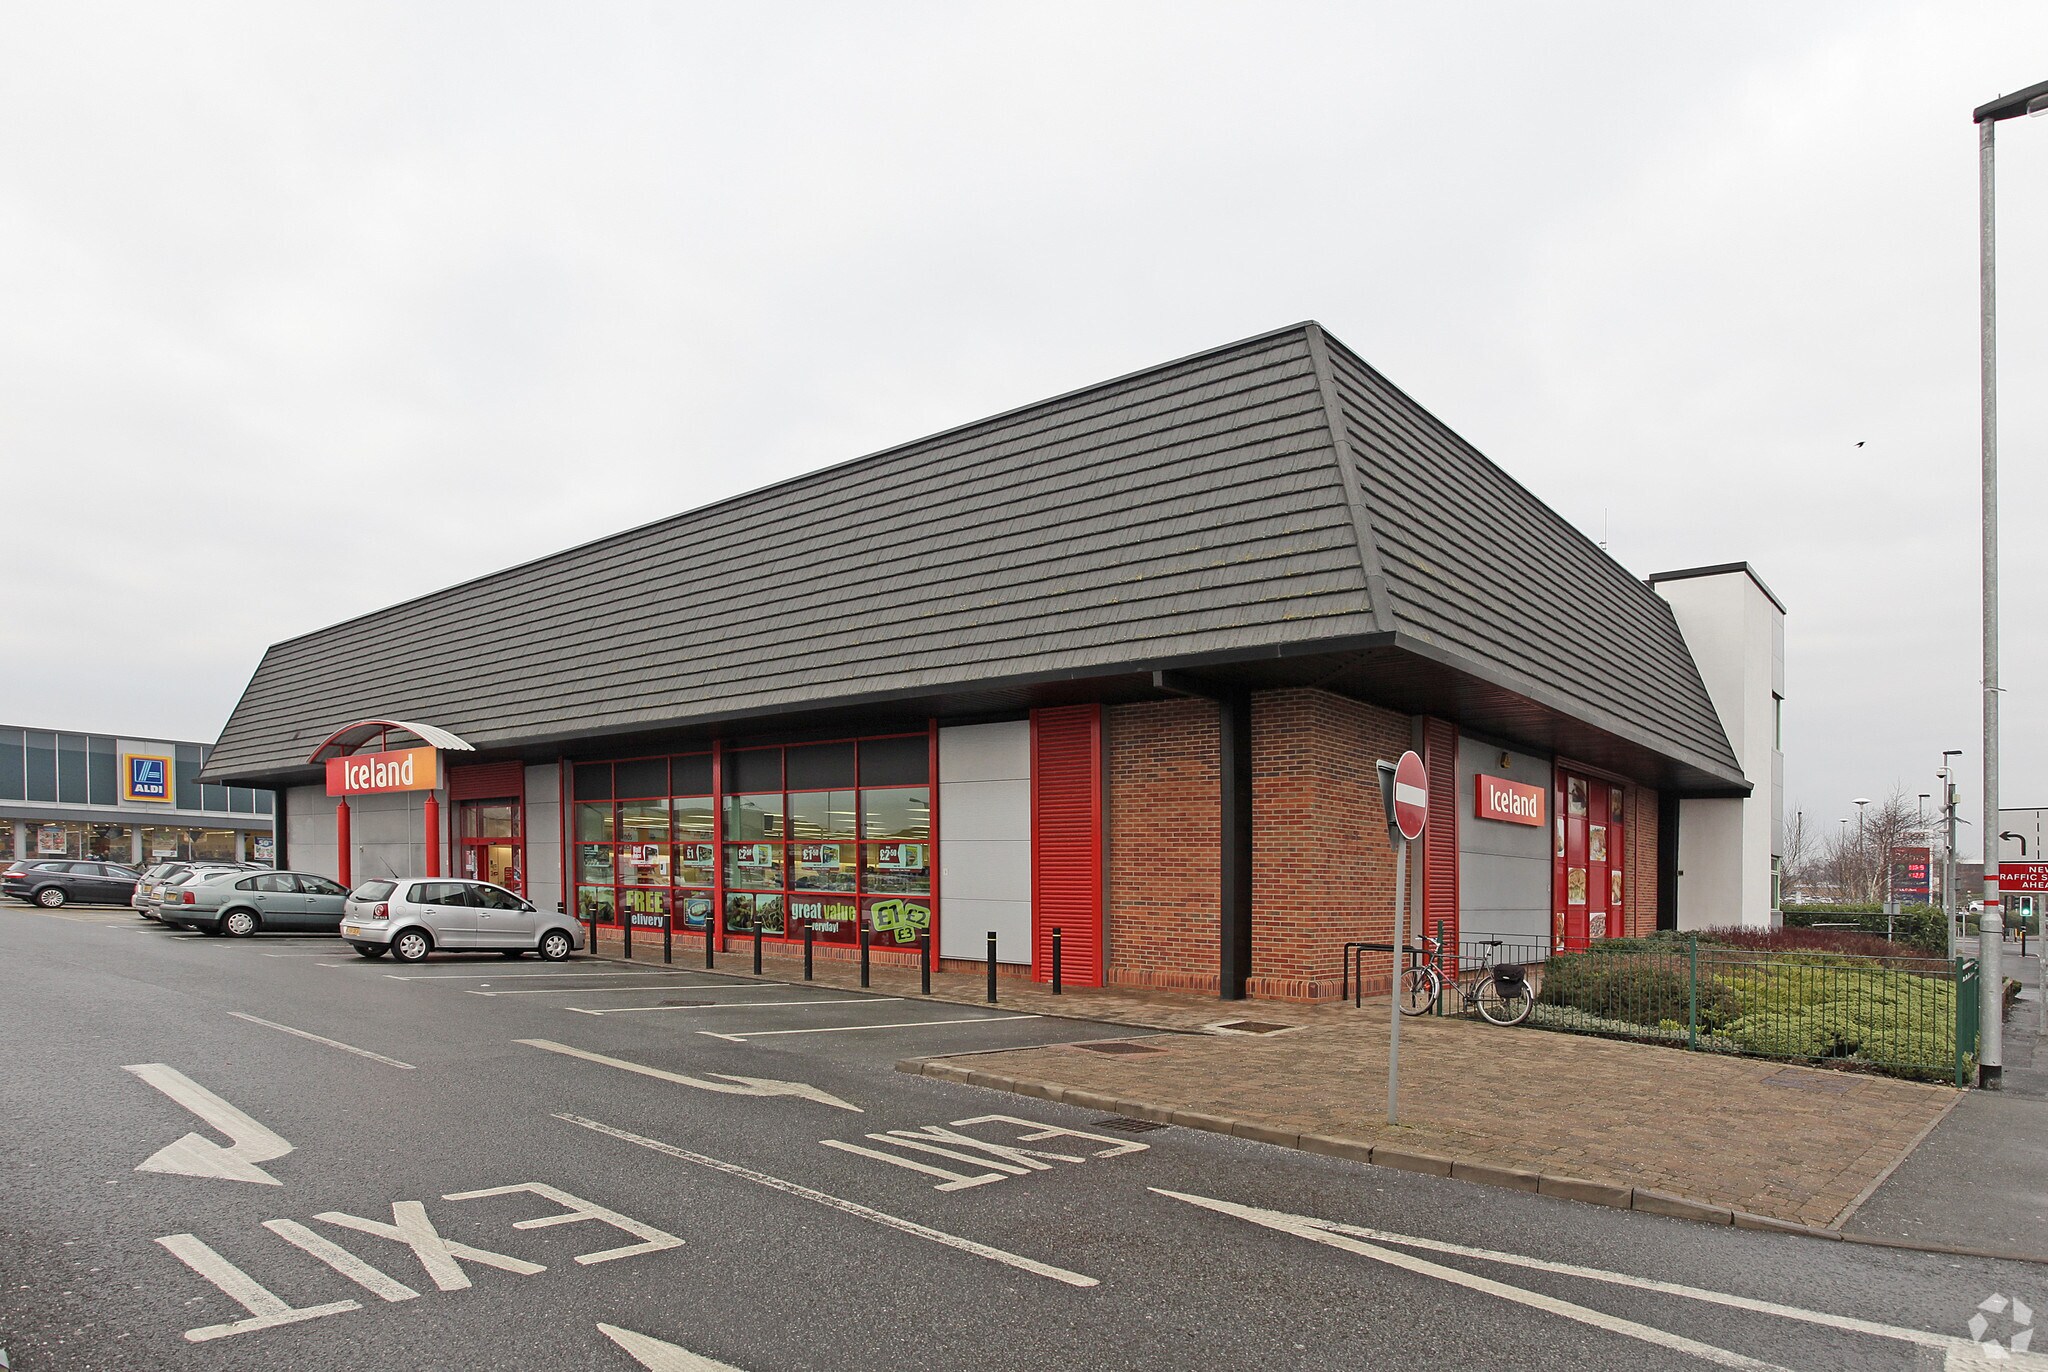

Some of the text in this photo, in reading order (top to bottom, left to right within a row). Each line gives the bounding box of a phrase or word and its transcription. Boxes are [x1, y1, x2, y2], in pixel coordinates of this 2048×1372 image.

[344, 753, 414, 790] Iceland
[134, 784, 163, 793] ALDI
[1490, 784, 1537, 818] Iceland
[2000, 873, 2037, 881] RAFFIC
[2021, 881, 2048, 889] AHEA
[626, 890, 664, 913] FREE
[631, 913, 663, 928] elivery
[791, 902, 857, 921] great value
[877, 904, 901, 926] £1
[906, 908, 927, 926] £2
[897, 927, 912, 940] £3
[818, 1114, 1151, 1192] EXIT
[154, 1181, 687, 1342] EXIT
